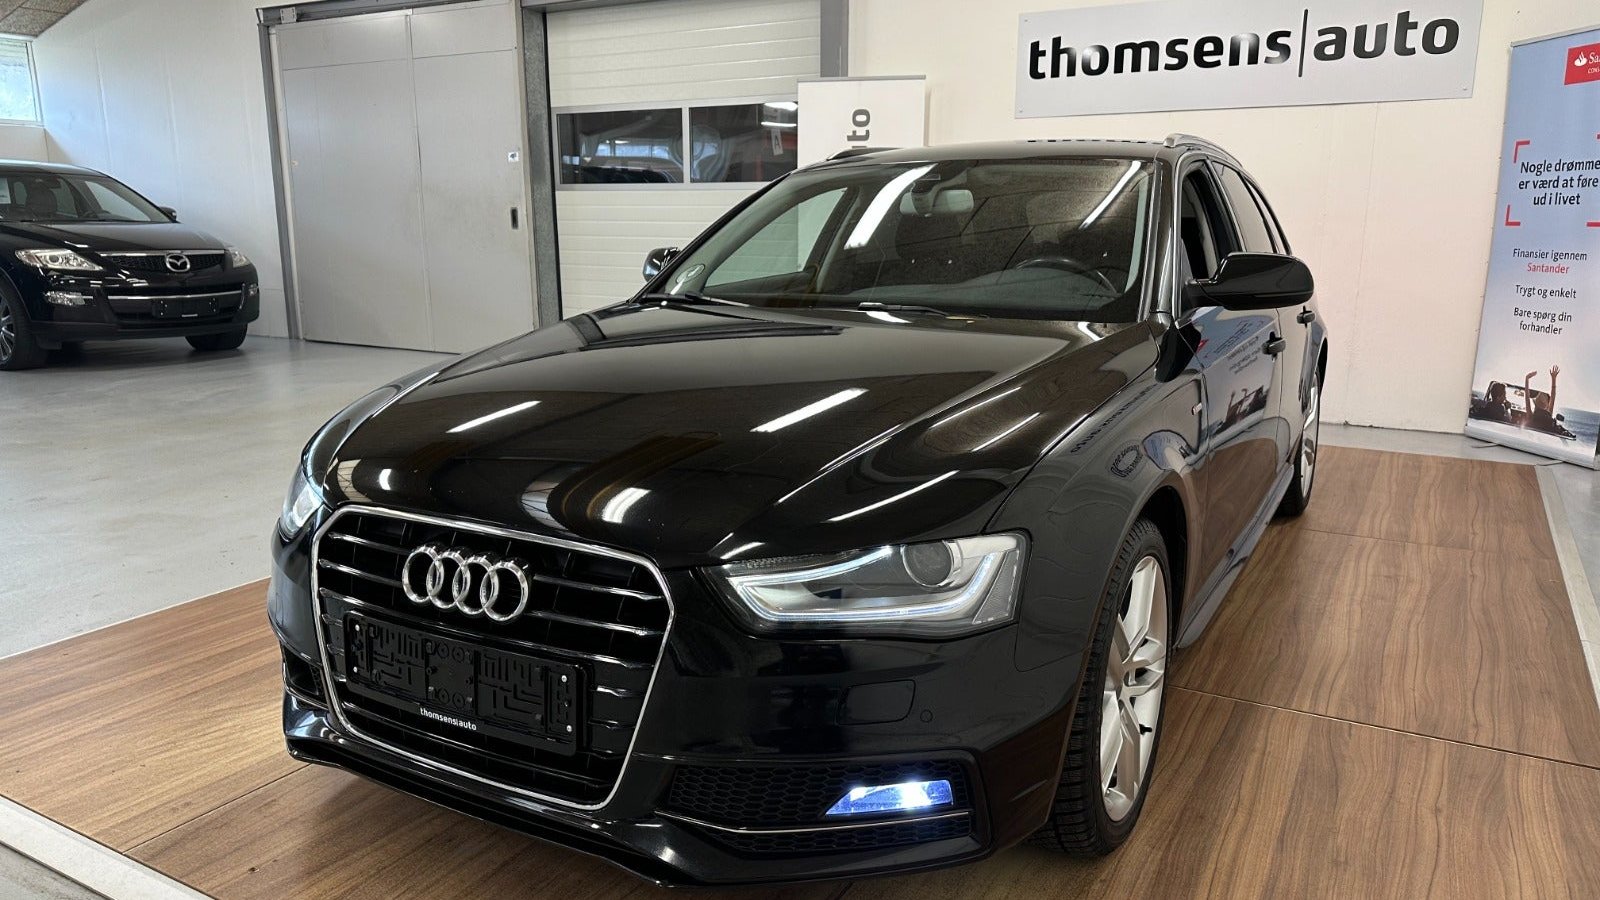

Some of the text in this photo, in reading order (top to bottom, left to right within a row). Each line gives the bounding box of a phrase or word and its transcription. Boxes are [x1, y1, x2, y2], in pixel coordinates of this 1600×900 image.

[847, 108, 870, 149] to
[1520, 159, 1600, 176] Nogle drømme
[1518, 174, 1599, 189] er værd at føre
[1533, 192, 1581, 205] ud i livet
[1512, 248, 1587, 262] Finansier igennem
[1527, 262, 1570, 274] Santander
[1515, 284, 1577, 299] Trygt og enkelt
[1513, 307, 1572, 323] Bare spørg din
[1519, 320, 1563, 335] forhandler
